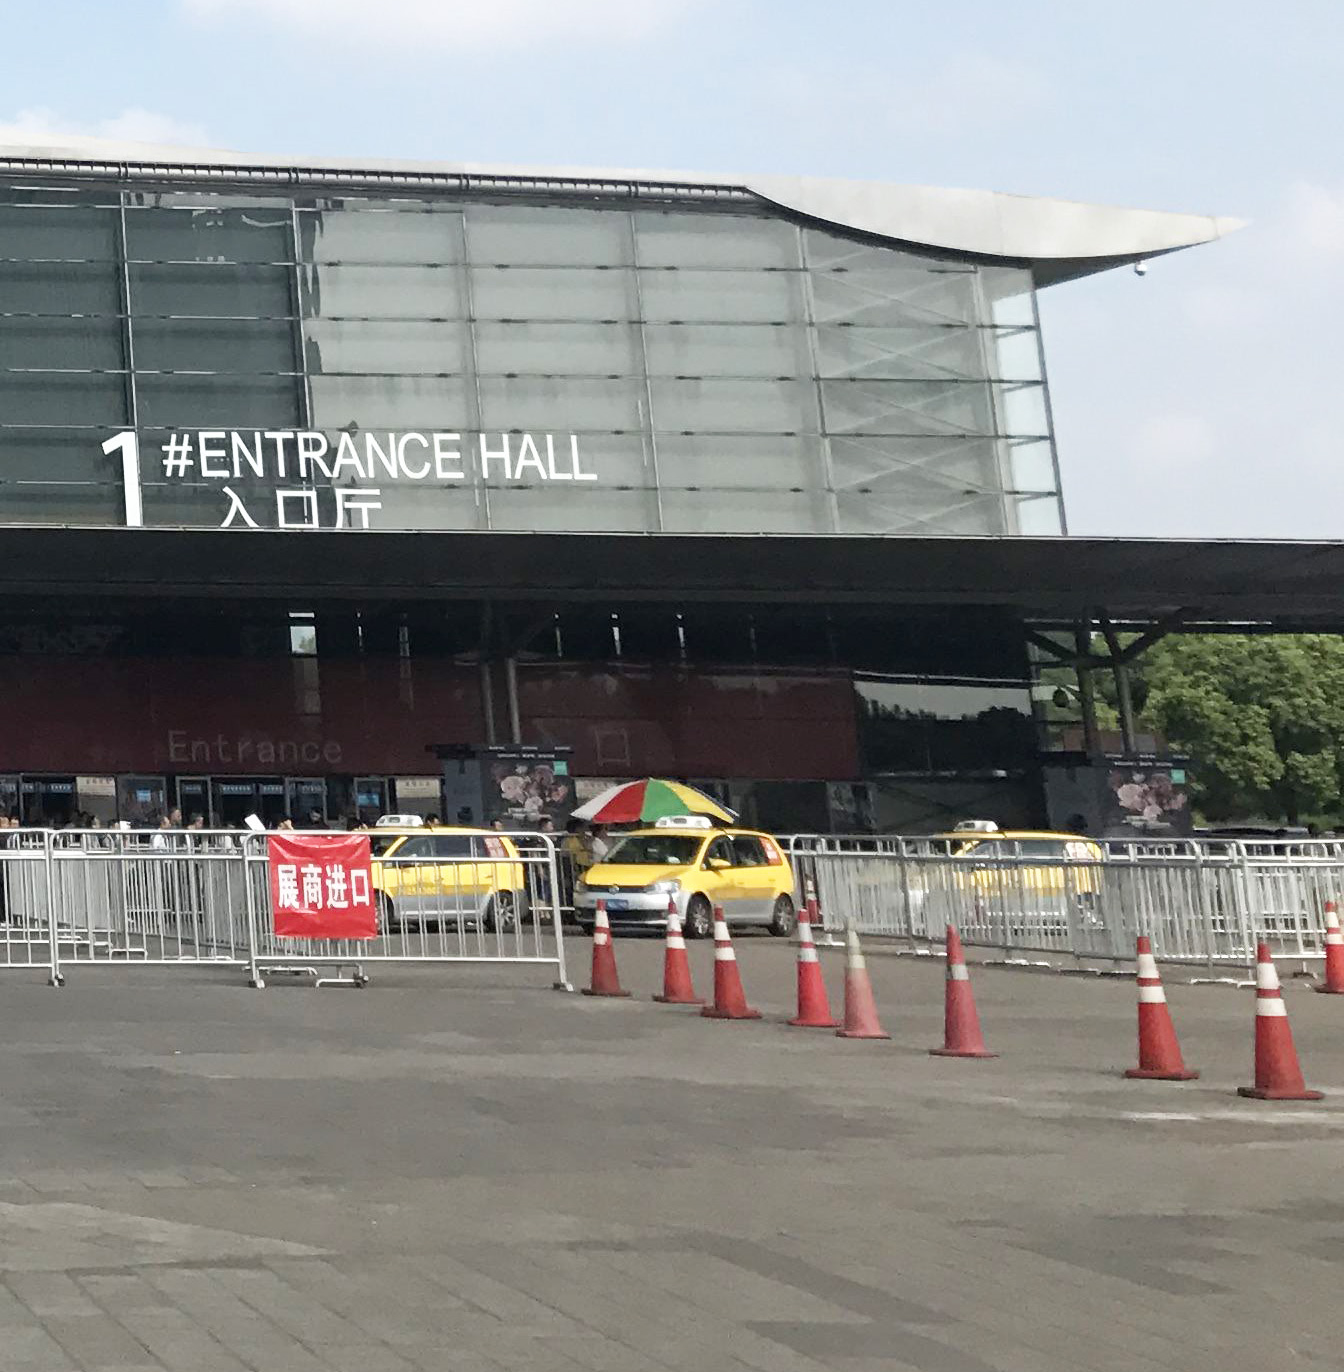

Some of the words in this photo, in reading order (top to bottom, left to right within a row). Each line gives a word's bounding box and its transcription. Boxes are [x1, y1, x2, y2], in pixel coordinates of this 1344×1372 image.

[101, 431, 143, 526] 1
[162, 431, 464, 478] #ENTRANCE
[479, 432, 598, 480] HALL
[220, 486, 382, 528] 入口厅
[168, 729, 342, 764] Entrance
[277, 863, 370, 910] 展商进口
